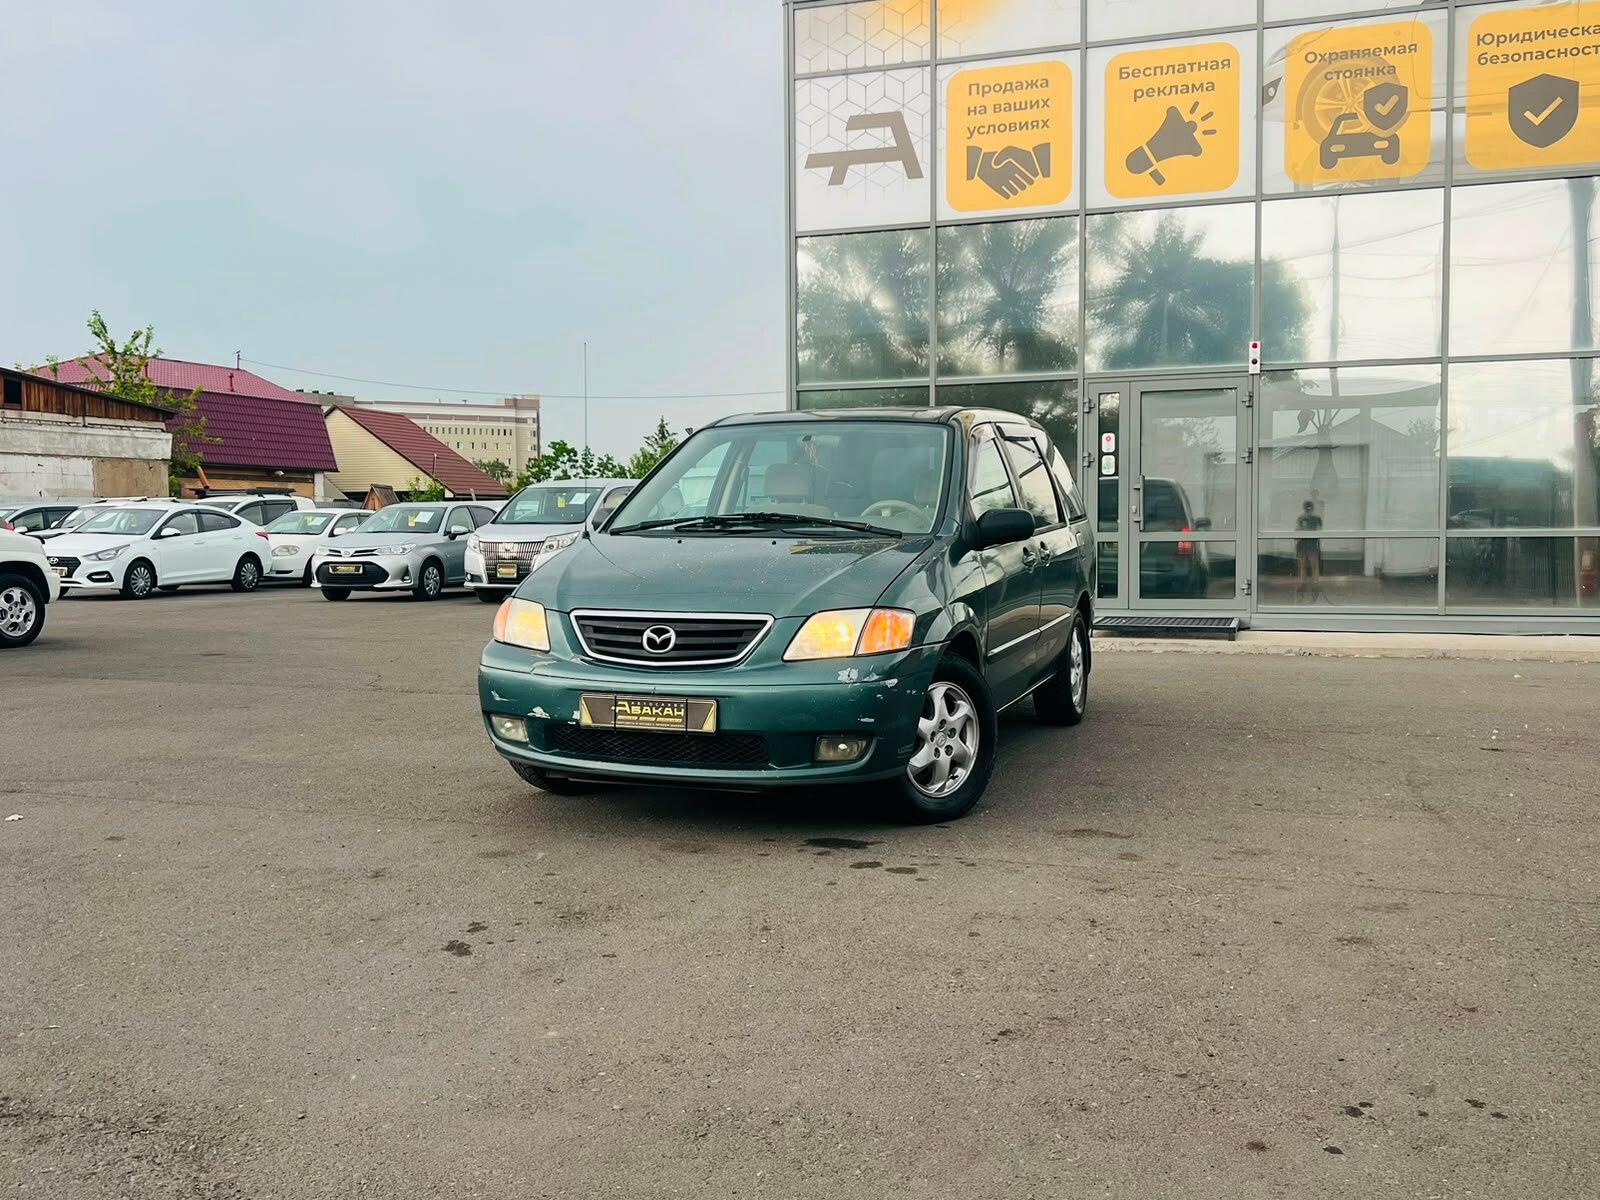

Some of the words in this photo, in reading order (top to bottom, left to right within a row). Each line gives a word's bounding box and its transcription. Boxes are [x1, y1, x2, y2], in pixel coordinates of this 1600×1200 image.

[1477, 25, 1600, 49] Юридическа
[1304, 43, 1418, 65] Охраняемая
[1477, 45, 1600, 66] безопасност
[1118, 57, 1232, 81] Бесплатная
[1324, 65, 1397, 81] стоянка
[968, 76, 1050, 98] Продажа
[1133, 81, 1216, 103] реклама
[966, 103, 988, 117] на
[993, 97, 1051, 114] ваших
[966, 117, 1051, 139] условиях
